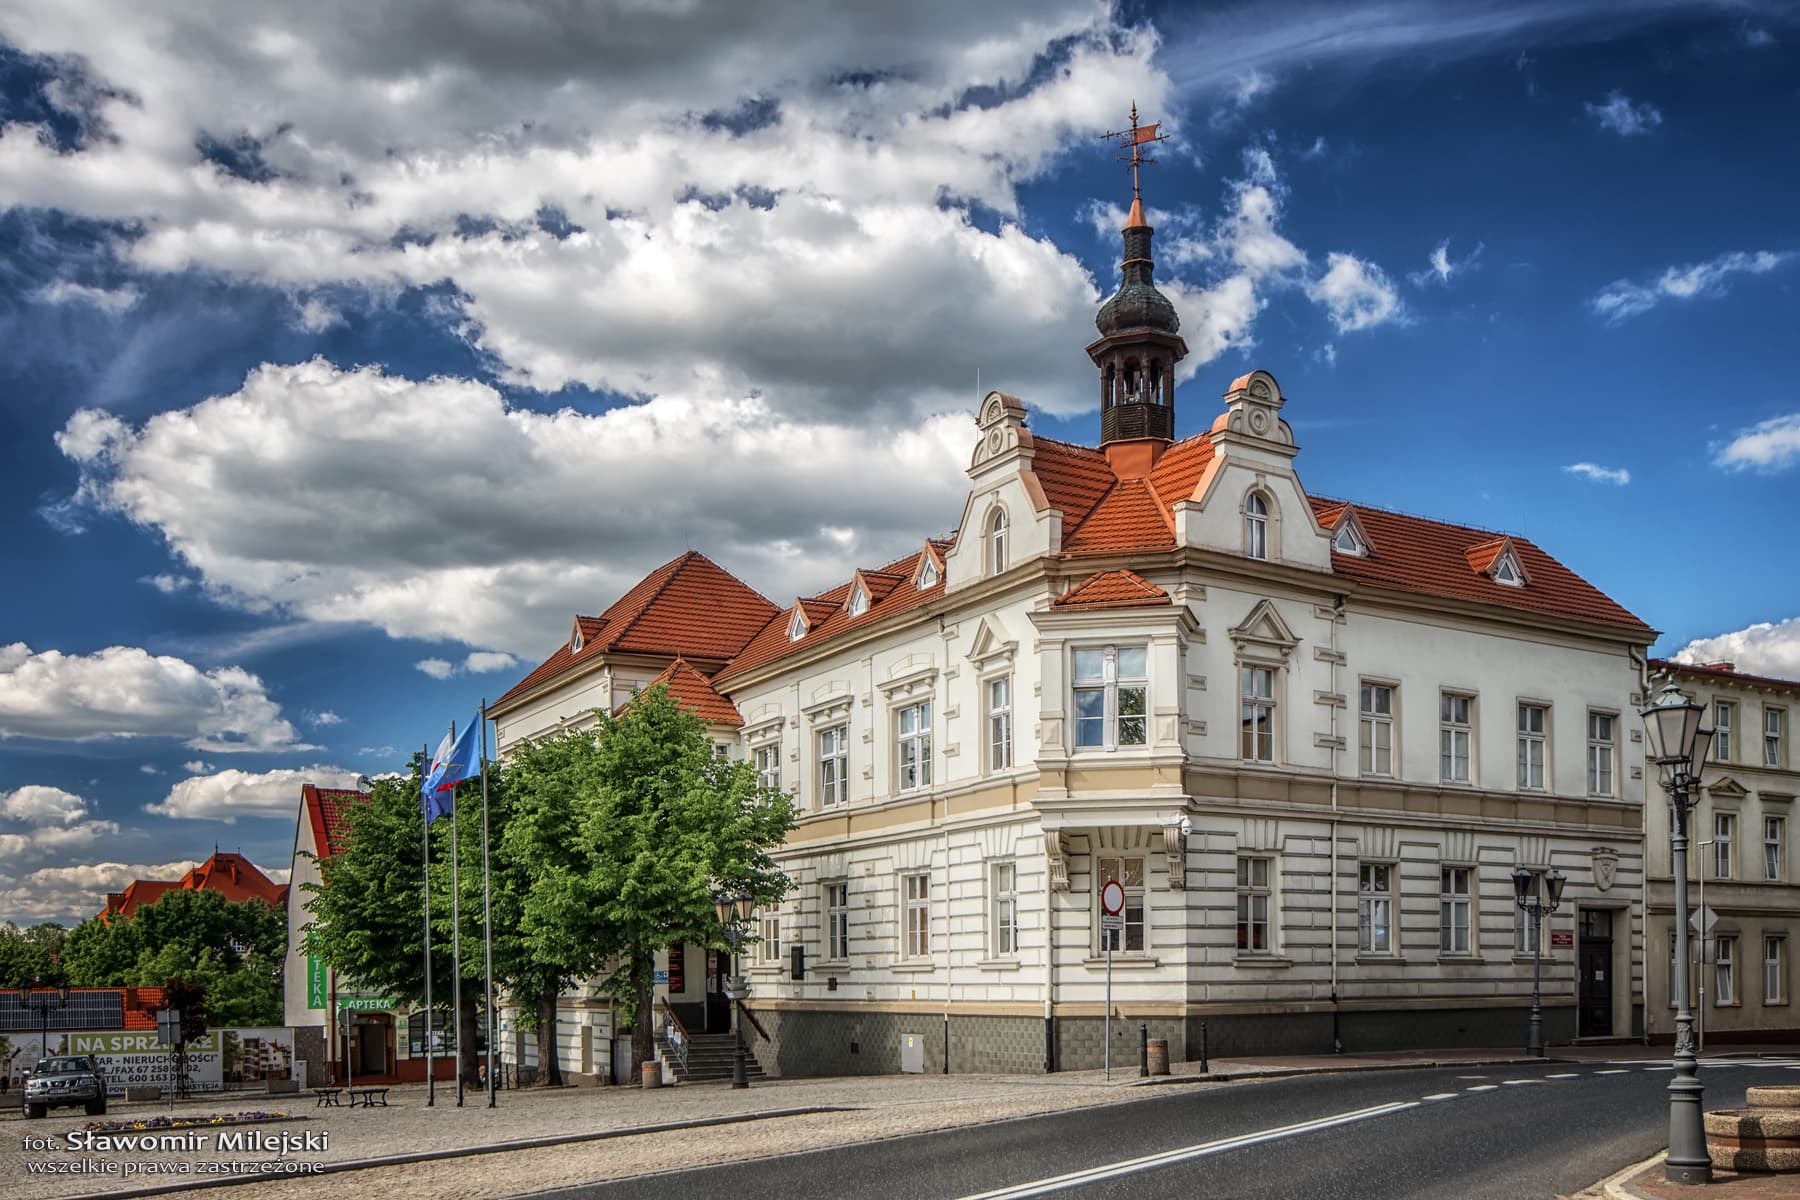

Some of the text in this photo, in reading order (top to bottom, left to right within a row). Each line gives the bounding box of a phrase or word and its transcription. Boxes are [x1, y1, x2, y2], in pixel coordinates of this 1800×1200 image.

[349, 1000, 391, 1009] APTEKA
[77, 1034, 213, 1051] NA SPRZAŻ
[137, 1065, 149, 1073] 67
[151, 1065, 169, 1073] 258
[105, 1074, 125, 1083] TEL.
[129, 1074, 148, 1082] 600
